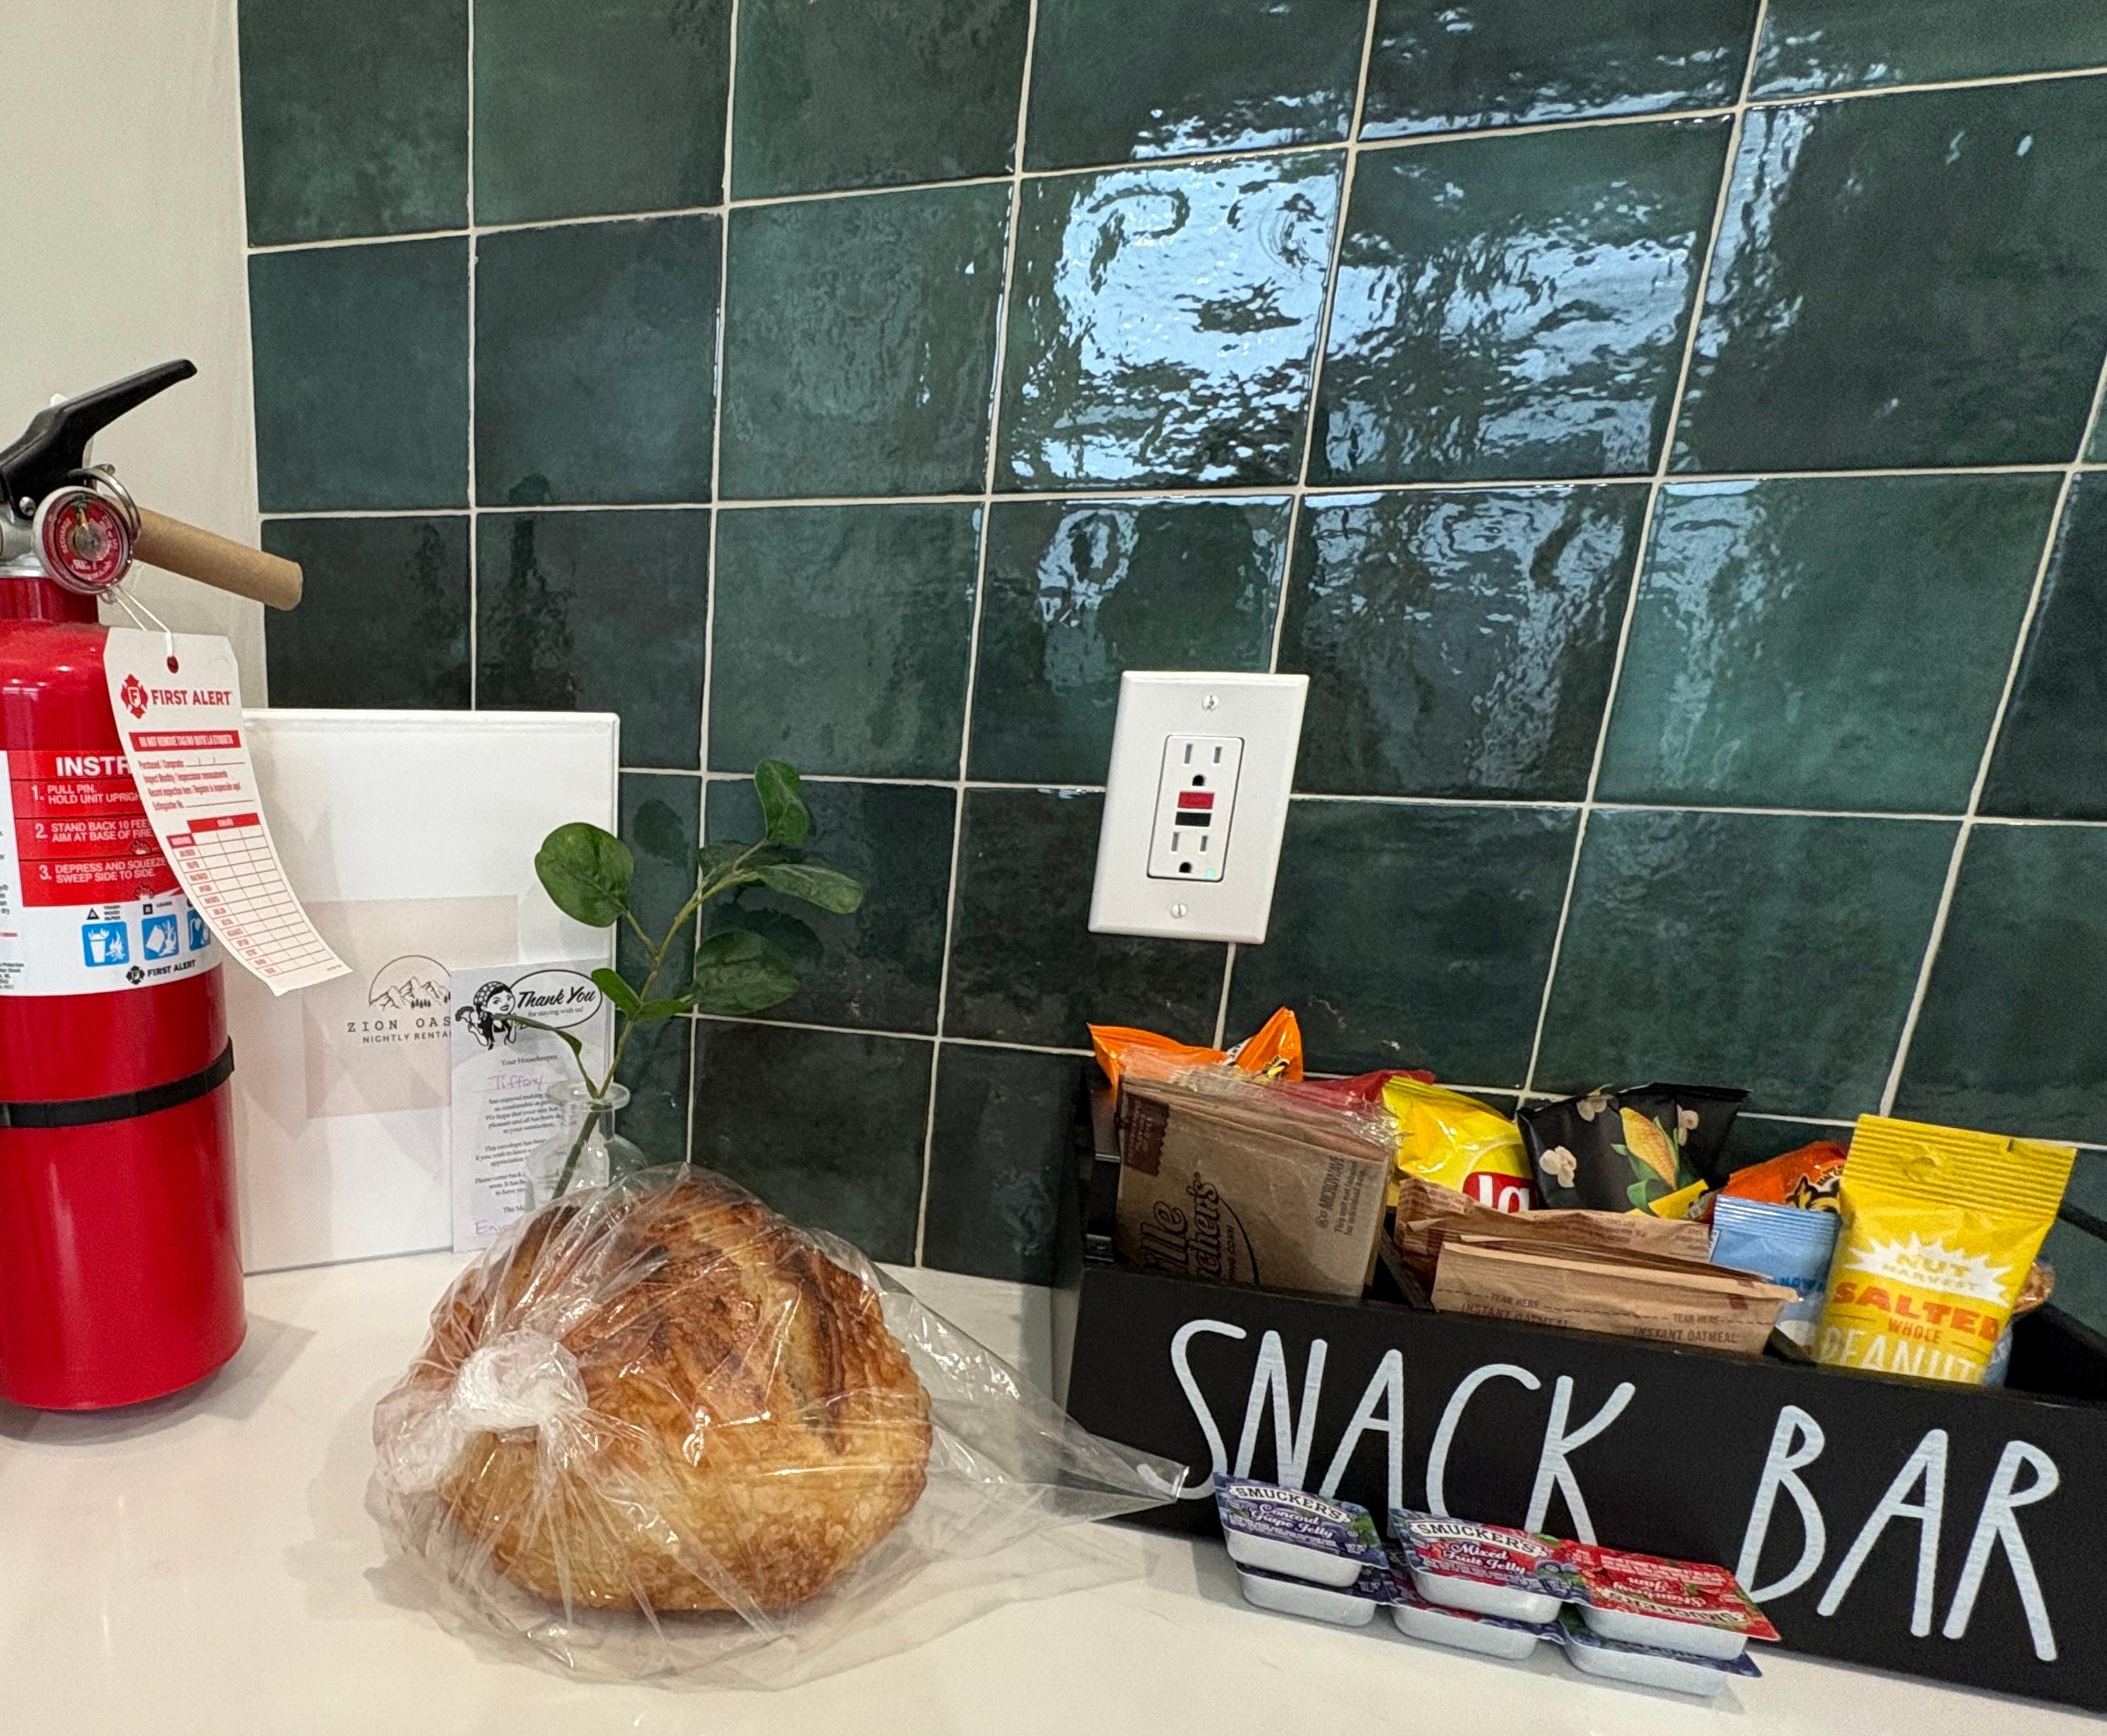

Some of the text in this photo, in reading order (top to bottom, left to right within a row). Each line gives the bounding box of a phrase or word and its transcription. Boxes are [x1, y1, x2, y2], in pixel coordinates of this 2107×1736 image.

[150, 690, 187, 705] FIRST
[193, 690, 232, 706] ALERT
[47, 784, 73, 795] PULL
[76, 784, 97, 794] PIN.
[48, 795, 78, 805] HOLD
[80, 794, 103, 803] UNIT
[51, 823, 86, 832] STAND
[89, 821, 116, 832] BACK
[119, 820, 129, 830] 10
[52, 832, 72, 843] AIM
[73, 832, 87, 841] AT
[90, 831, 117, 841] BASE
[118, 830, 131, 840] OF
[39, 858, 166, 880] 3. DEPRESS AND SQUEEZE
[56, 873, 92, 883] SWEEP
[94, 872, 117, 882] SIDE
[120, 870, 132, 879] TO
[147, 966, 171, 977] FIRST
[174, 959, 196, 971] ALERT
[518, 986, 596, 1008] Thank You
[347, 1020, 397, 1033] ZION
[363, 1034, 410, 1043] NIGHTLY
[1896, 1253, 1971, 1277] NUT
[1882, 1263, 1980, 1290] HARVEST
[1491, 1293, 1513, 1305] TEAR
[1673, 1313, 1720, 1323] TEAR HERE
[1633, 1327, 1737, 1344] INSTANT OATMEAL
[1888, 1318, 1942, 1344] WHOLE
[1170, 1319, 2061, 1662] SNACK BAR
[1235, 1487, 1343, 1520] SMUCKER'S
[1259, 1503, 1320, 1525] Concord
[1251, 1510, 1293, 1528] Grape
[1295, 1523, 1333, 1539] Jelly
[1418, 1523, 1536, 1554] SMUCKER'S
[1450, 1542, 1509, 1560] Mixed
[1442, 1549, 1483, 1566] Fruit
[1486, 1558, 1526, 1575] Jelly
[1627, 1577, 1668, 1591] Jam
